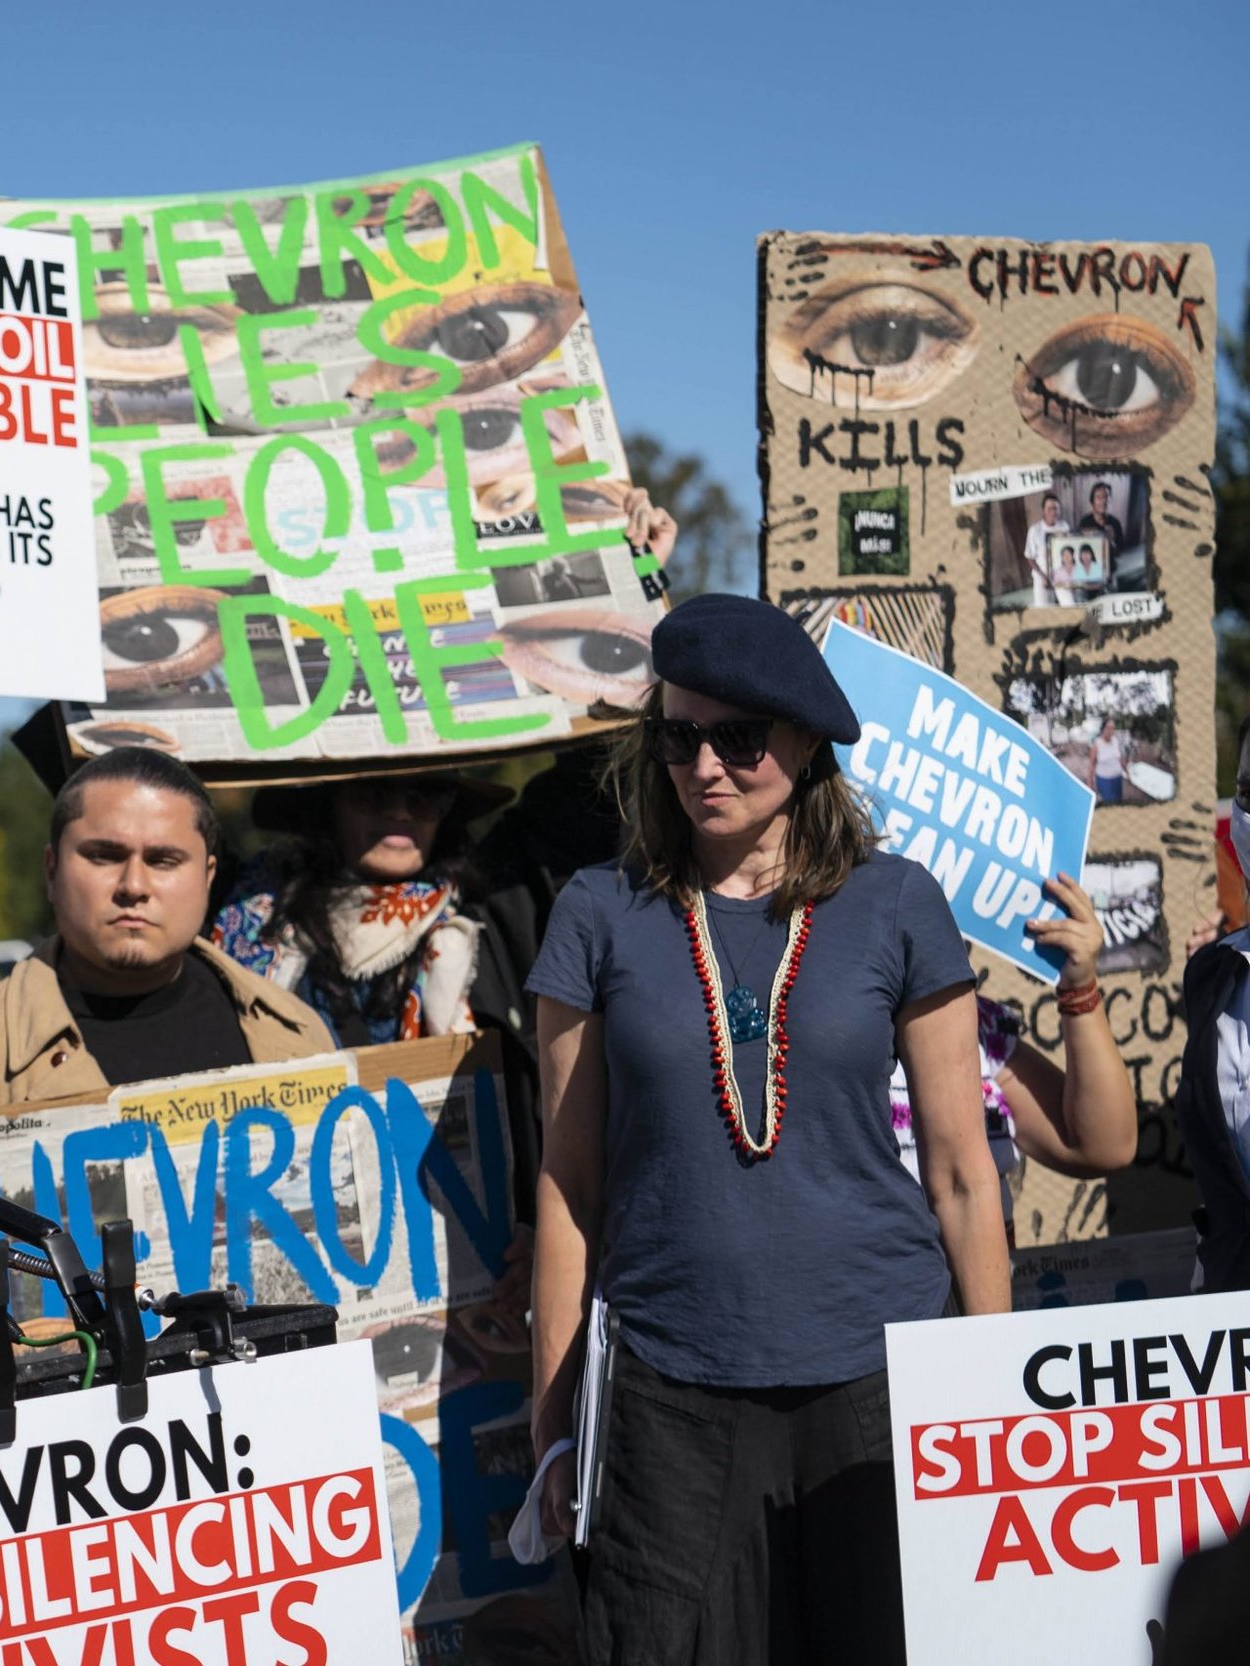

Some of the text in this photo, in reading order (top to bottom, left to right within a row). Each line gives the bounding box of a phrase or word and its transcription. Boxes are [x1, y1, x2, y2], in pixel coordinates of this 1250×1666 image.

[4, 153, 538, 320] HEVRON
[967, 246, 1190, 300] CHEVRON
[798, 417, 966, 472] KILLS
[9, 531, 53, 566] ITS
[1111, 599, 1152, 618] LOST
[217, 573, 552, 751] DIE
[906, 684, 1031, 799] MAKE
[850, 721, 1054, 878] CHEVRON
[862, 792, 1056, 952] EAN UP!
[168, 1096, 217, 1129] New
[279, 1078, 349, 1110] Times
[916, 1397, 1250, 1493] STOP SIL
